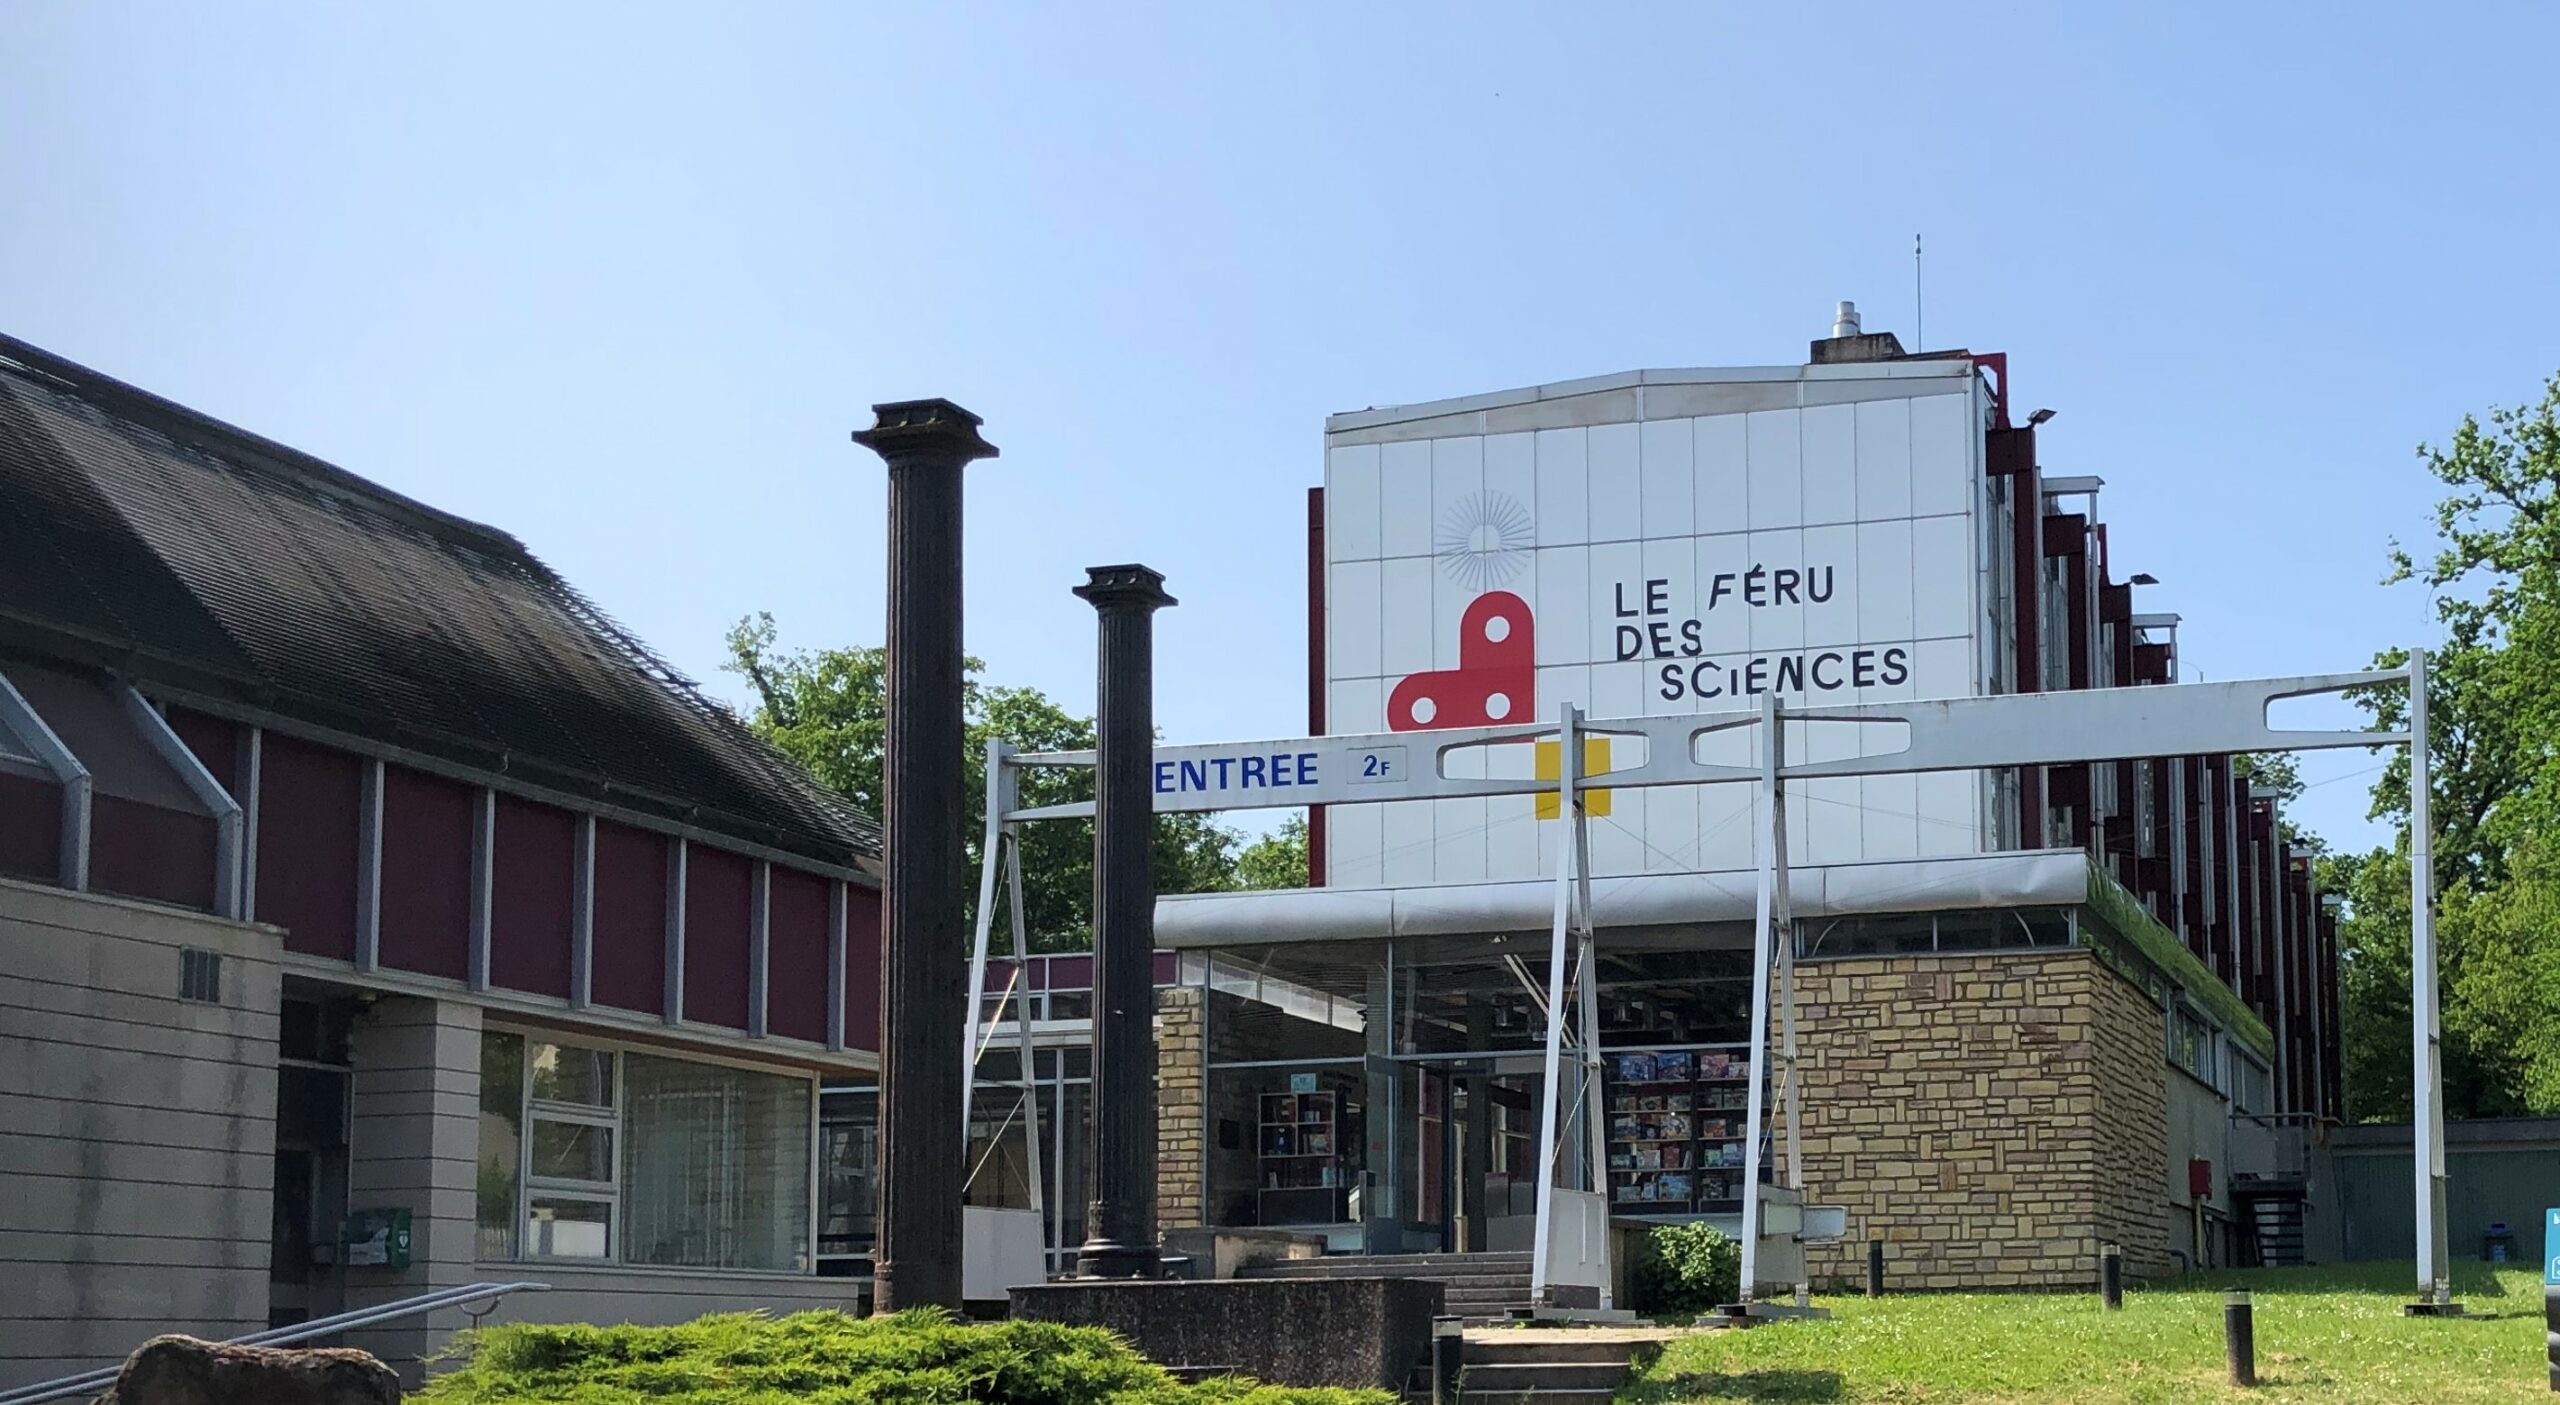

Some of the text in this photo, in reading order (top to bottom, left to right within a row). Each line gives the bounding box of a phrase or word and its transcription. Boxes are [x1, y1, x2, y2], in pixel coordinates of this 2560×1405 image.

[1615, 562, 1834, 618] LE FÉRU
[1616, 619, 1703, 662] DES
[1660, 648, 1908, 701] SCIENCES
[1155, 753, 1318, 793] ENTREE
